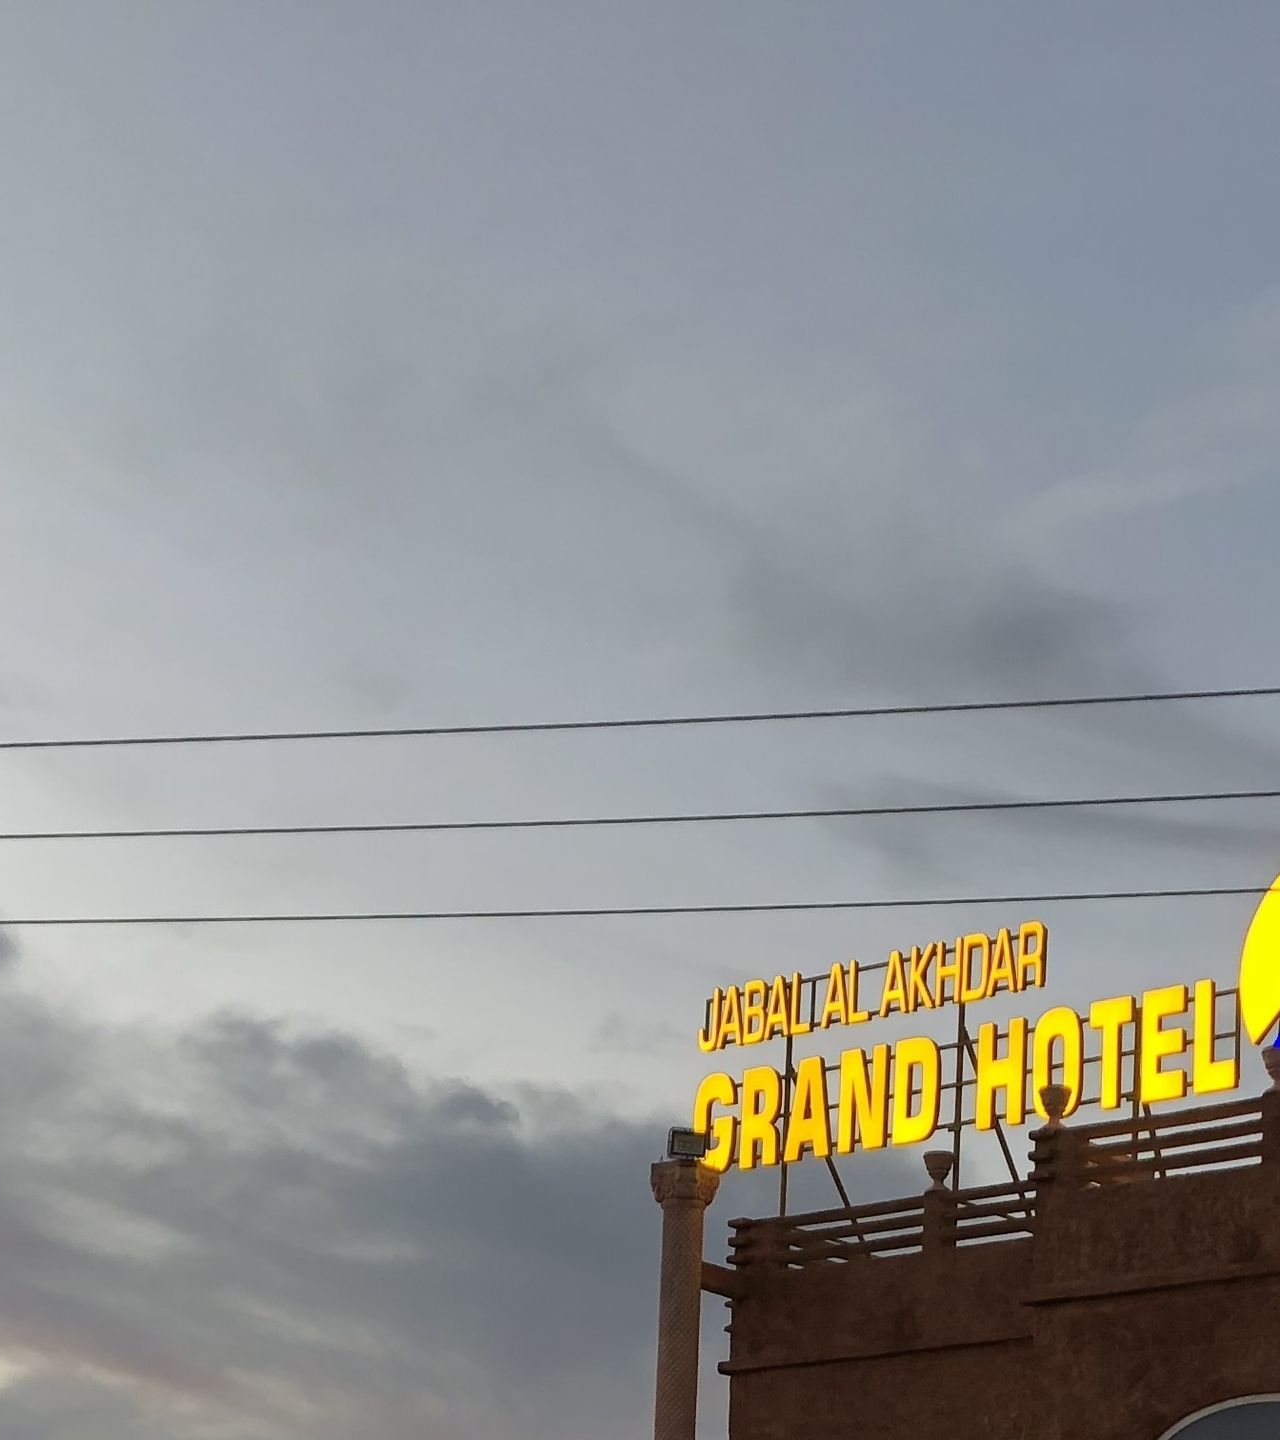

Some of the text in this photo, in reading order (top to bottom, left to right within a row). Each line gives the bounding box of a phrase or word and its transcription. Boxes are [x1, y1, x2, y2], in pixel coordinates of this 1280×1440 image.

[697, 920, 1048, 1054] JABAL AL AKHDAR
[692, 978, 1240, 1174] GRAND HOTEL
